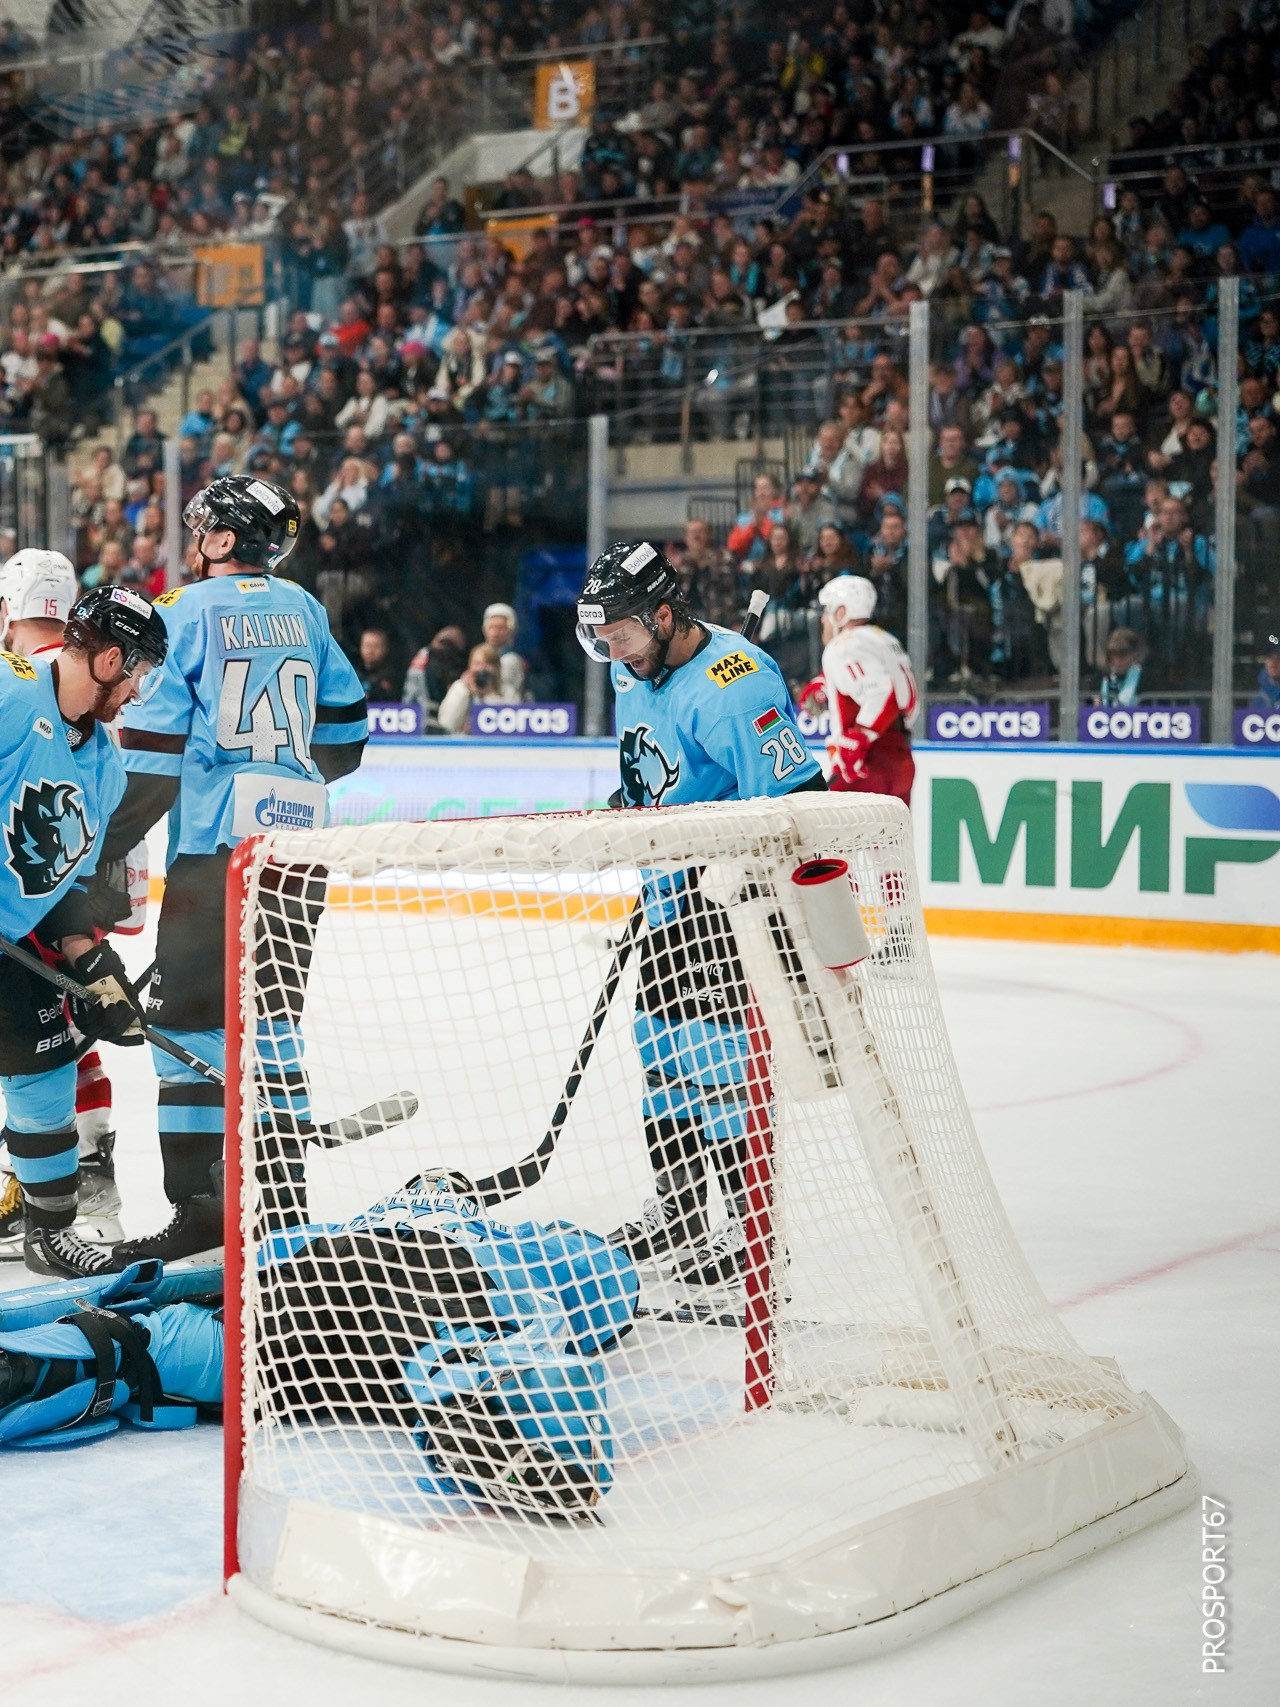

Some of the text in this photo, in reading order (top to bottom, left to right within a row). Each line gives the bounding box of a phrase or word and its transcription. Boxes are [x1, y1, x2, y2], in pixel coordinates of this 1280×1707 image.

[583, 579, 602, 594] 28
[44, 599, 58, 616] 15
[115, 621, 140, 636] CCM
[220, 614, 308, 650] KALININ
[711, 653, 744, 677] MAX
[720, 661, 754, 684] LINE
[847, 662, 865, 680] 11
[216, 657, 317, 774] 40
[368, 707, 418, 732] газ
[760, 725, 807, 782] 28
[277, 800, 315, 819] ГАЗПРОМ
[931, 777, 1280, 896] МИР
[183, 1050, 226, 1087] TR
